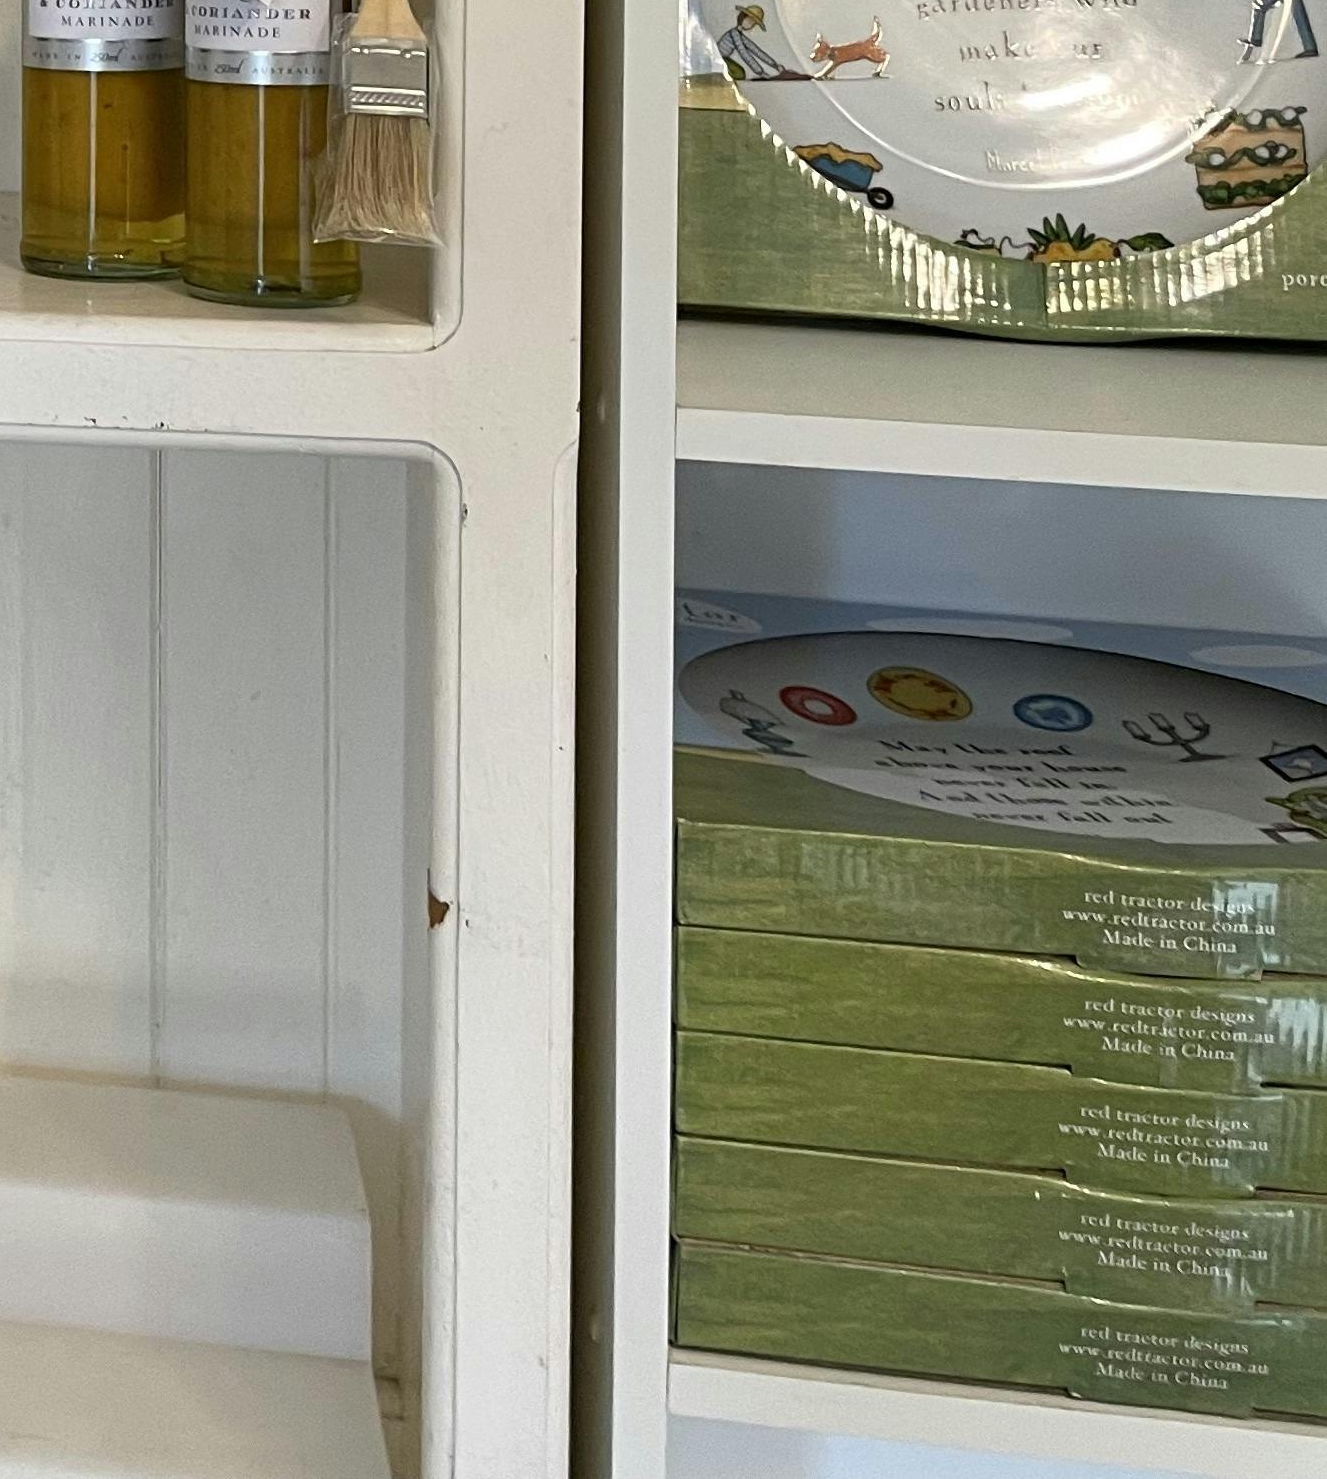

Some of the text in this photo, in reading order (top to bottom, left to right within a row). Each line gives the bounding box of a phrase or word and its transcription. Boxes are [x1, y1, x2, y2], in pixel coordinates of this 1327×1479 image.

[61, 16, 155, 27] MARINADE
[1085, 891, 1254, 915] red tractor designs
[1063, 910, 1276, 935] www.redtractor.com.au
[1103, 929, 1237, 953] Made in China
